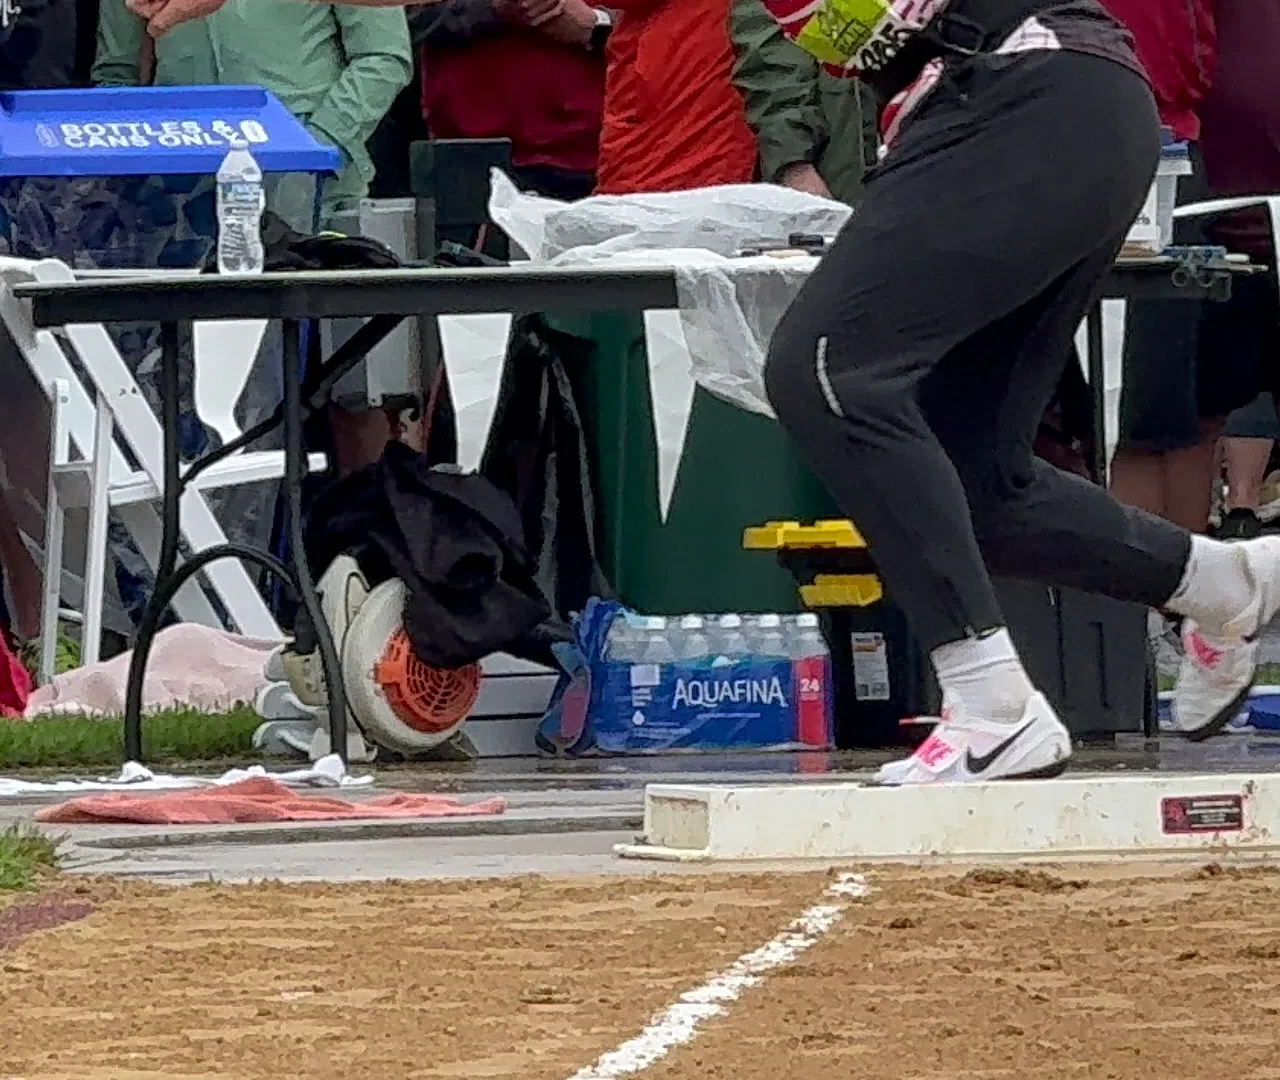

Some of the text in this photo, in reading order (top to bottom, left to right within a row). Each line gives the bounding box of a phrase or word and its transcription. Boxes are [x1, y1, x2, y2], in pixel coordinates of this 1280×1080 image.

[60, 120, 204, 138] BOTTLES
[64, 134, 150, 148] CANS
[672, 677, 789, 709] AQUAFINA
[800, 677, 819, 693] 24
